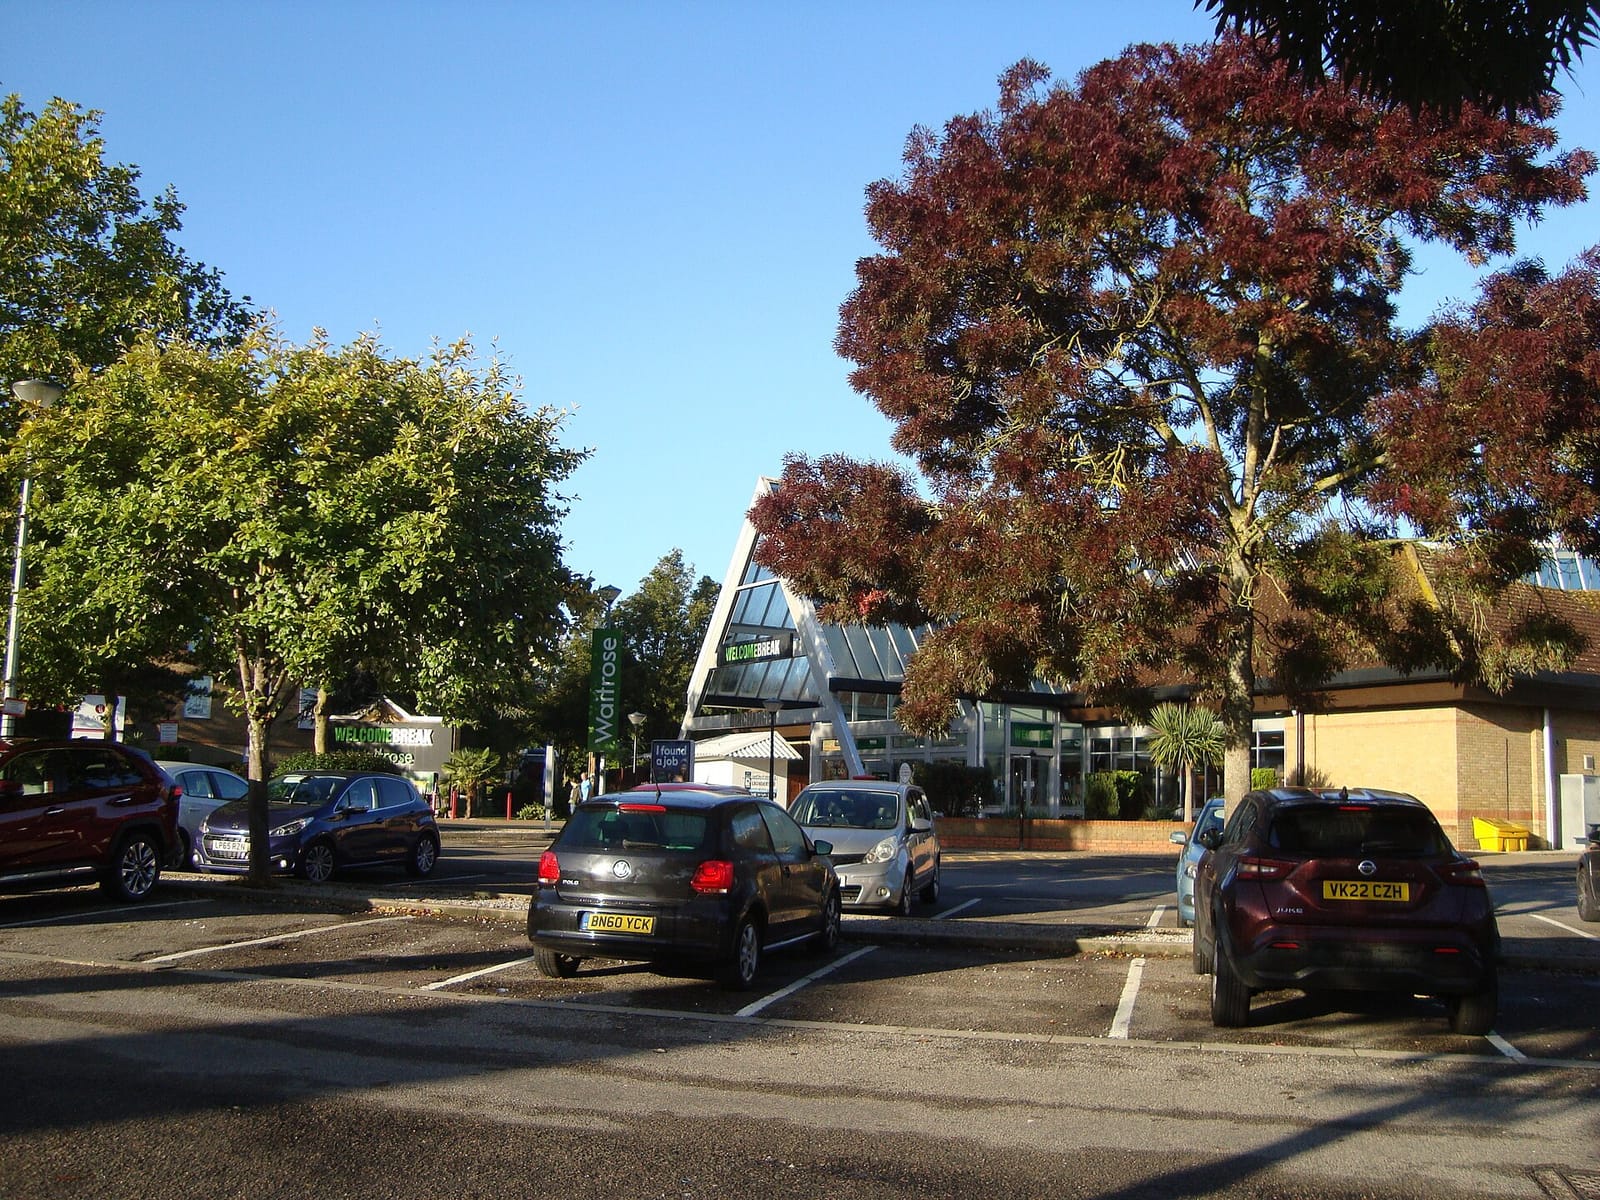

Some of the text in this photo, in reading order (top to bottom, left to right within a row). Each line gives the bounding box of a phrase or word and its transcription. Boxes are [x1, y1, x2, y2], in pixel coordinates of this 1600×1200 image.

[594, 637, 617, 744] Waitrose
[656, 744, 687, 755] I found
[662, 757, 679, 768] job
[1329, 882, 1402, 898] VK22 CZH
[591, 915, 650, 930] BN60 YCK
